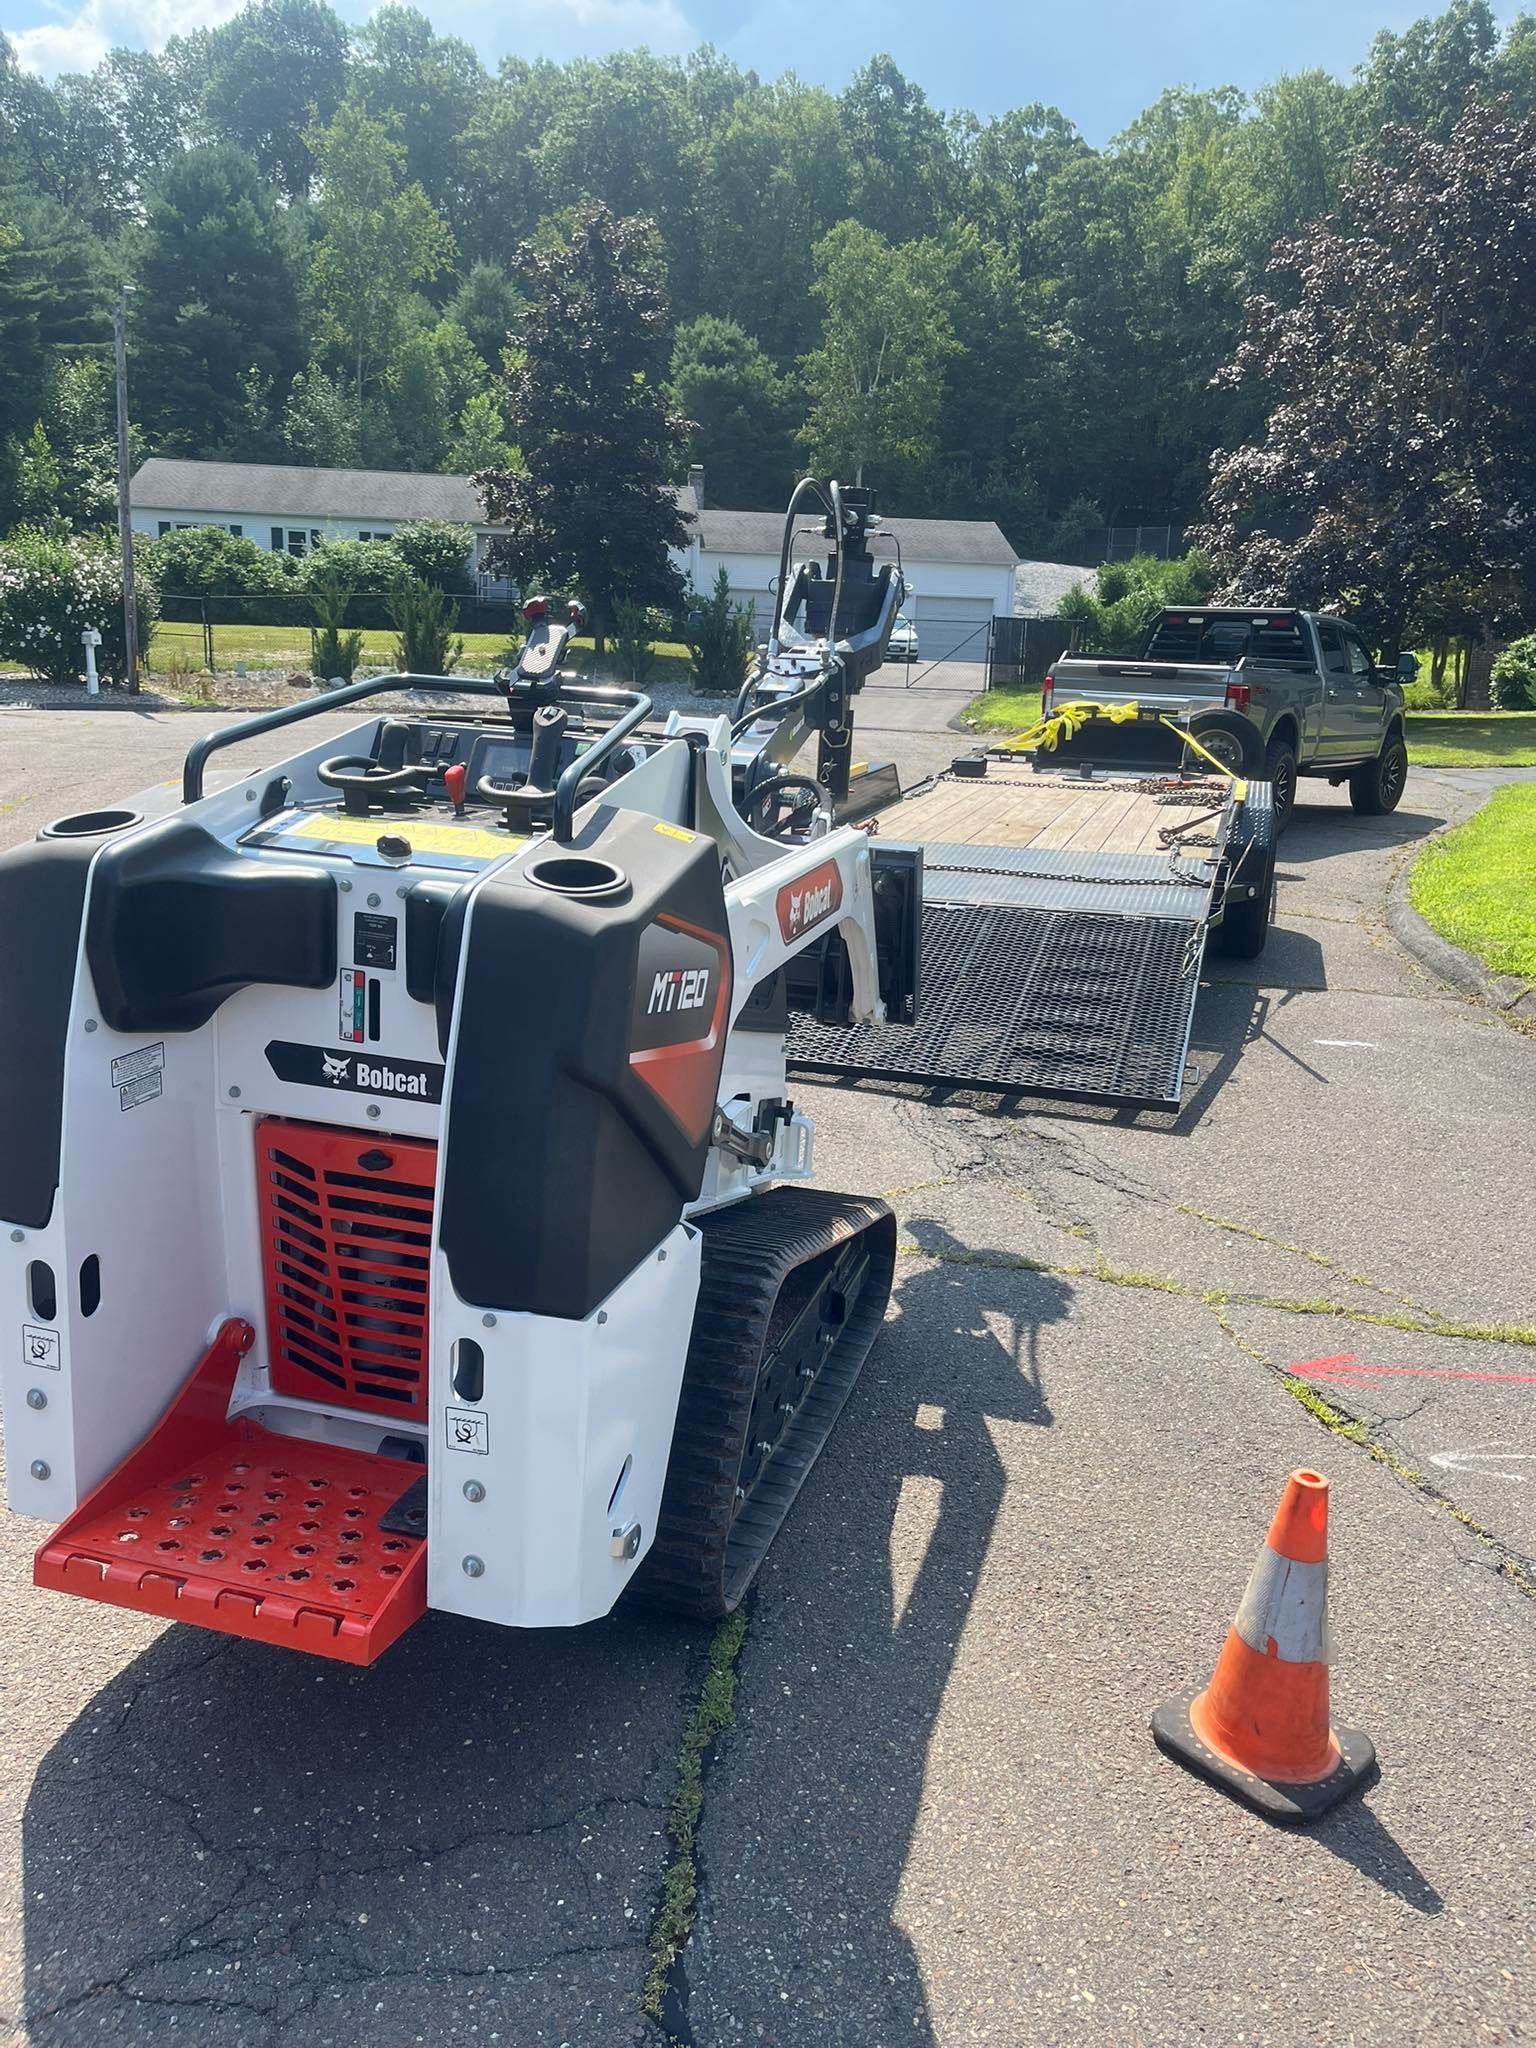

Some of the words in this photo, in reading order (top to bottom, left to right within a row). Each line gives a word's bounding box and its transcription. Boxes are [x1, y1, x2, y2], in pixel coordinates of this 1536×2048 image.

[803, 879, 832, 925] Bobcat
[647, 969, 709, 1014] MT120
[356, 1062, 427, 1096] Bobcat
